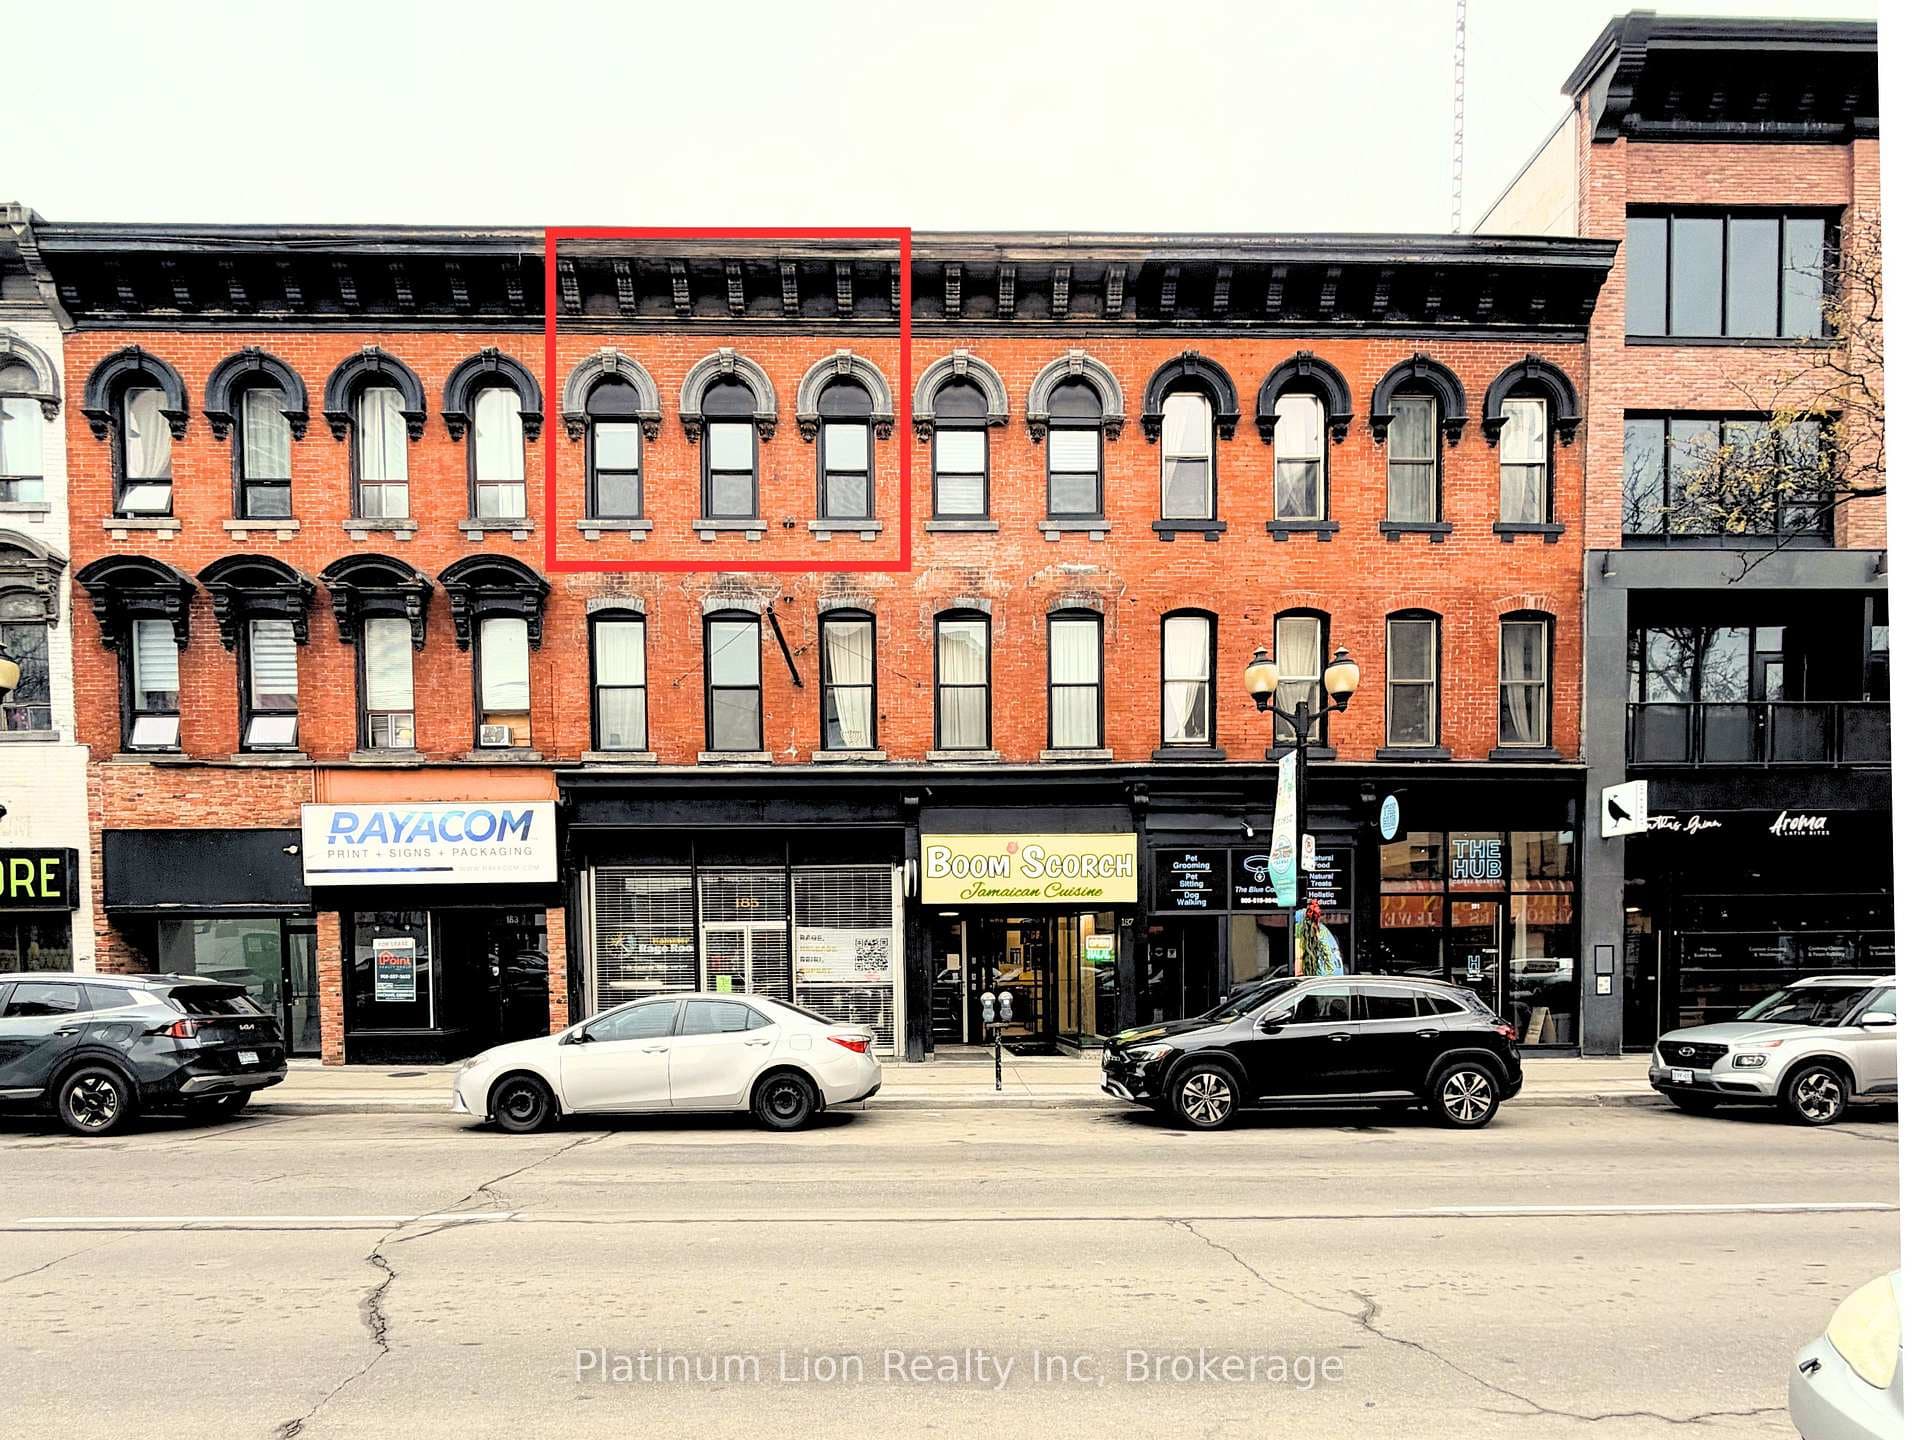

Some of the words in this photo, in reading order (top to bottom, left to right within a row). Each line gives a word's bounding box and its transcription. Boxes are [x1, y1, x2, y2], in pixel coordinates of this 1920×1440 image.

[327, 809, 534, 845] RAYACOM
[1768, 810, 1828, 836] Aroma
[328, 849, 369, 859] PRINT
[389, 848, 431, 858] SIGNS
[452, 847, 533, 857] PACKAGING
[1452, 839, 1502, 859] THE
[926, 845, 1011, 879] BOOM
[1020, 844, 1134, 879] SCORCH
[1185, 854, 1198, 862] Pet
[1172, 861, 1211, 870] Grooming
[1452, 859, 1503, 879] HUB
[1185, 872, 1198, 881] Pet
[1309, 872, 1334, 880] Natural
[1179, 880, 1204, 889] Sitting
[1235, 885, 1248, 893] The
[1248, 885, 1264, 893] Blue
[960, 881, 1041, 900] Jamaican
[1043, 881, 1103, 898] Cuisine
[1184, 891, 1200, 901] Dog
[736, 897, 759, 908] 185
[1176, 898, 1207, 907] Walking
[1121, 917, 1134, 927] 187
